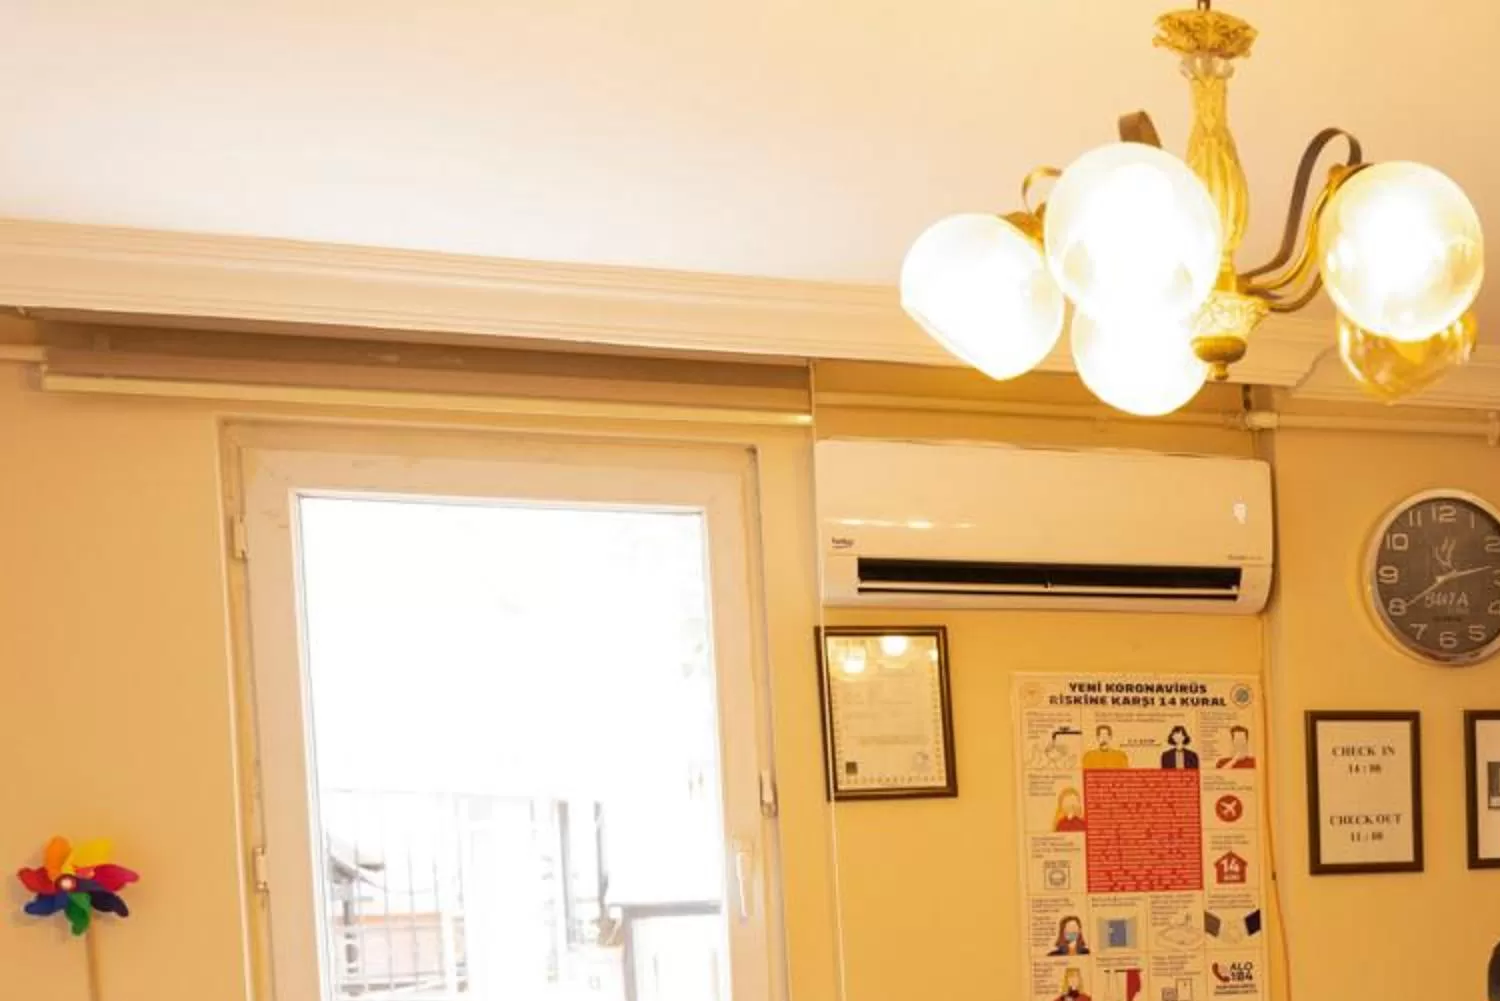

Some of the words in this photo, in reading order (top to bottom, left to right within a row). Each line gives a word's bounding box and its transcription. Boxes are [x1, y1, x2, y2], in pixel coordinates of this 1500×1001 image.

[1408, 510, 1423, 528] 11
[1431, 503, 1457, 523] 12
[1469, 511, 1476, 529] 1
[1385, 533, 1409, 551] 10
[1378, 565, 1399, 584] 9
[1388, 598, 1407, 616] 8
[1410, 623, 1428, 640] 7
[1439, 631, 1458, 648] 6
[1468, 624, 1487, 641] 5
[1069, 682, 1101, 693] YENİ
[1105, 682, 1208, 694] KORONAVİRÜS
[1049, 693, 1107, 705] RİSKİNE
[1111, 696, 1155, 708] KARŞI
[1159, 697, 1177, 706] 14
[1180, 697, 1227, 707] KURAL
[1331, 746, 1376, 756] CHECK
[1381, 745, 1396, 756] IN
[1330, 815, 1374, 825] CHECK
[1375, 813, 1402, 824] OUT
[1220, 858, 1240, 872] 14
[1230, 961, 1253, 971] ALO
